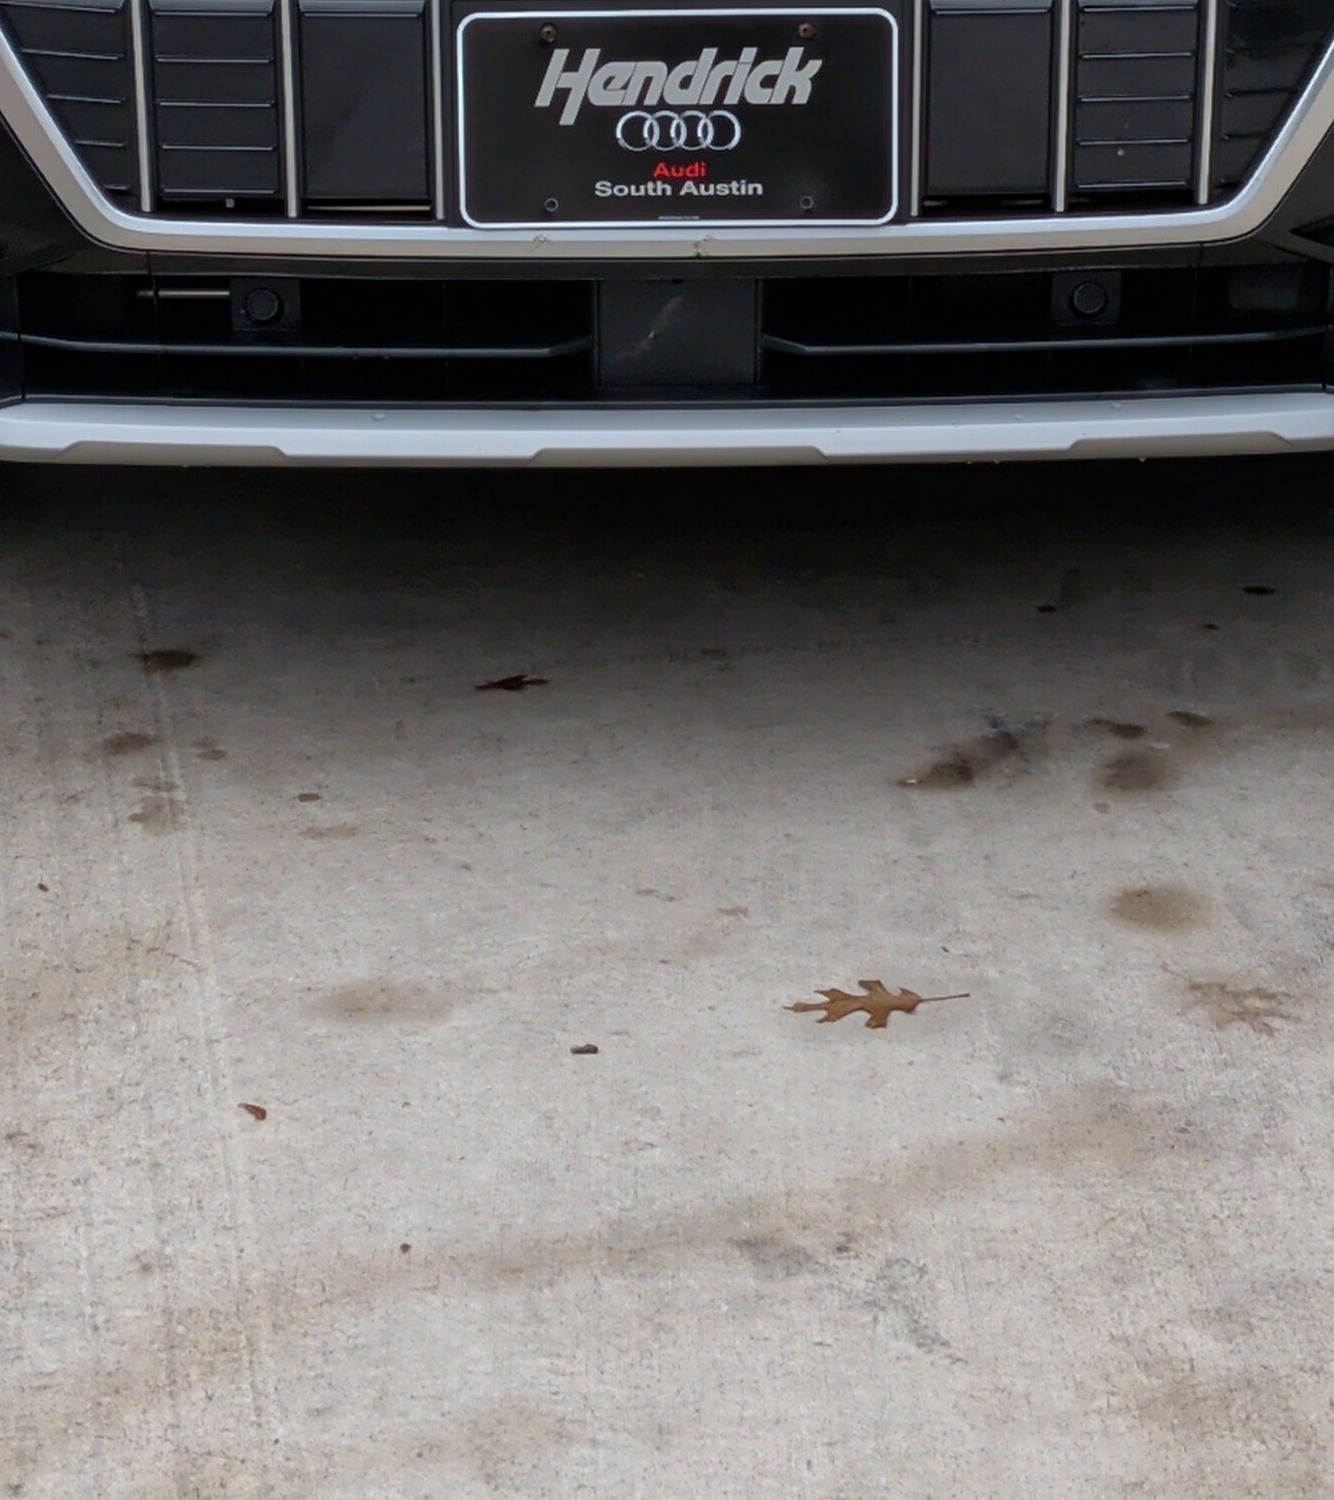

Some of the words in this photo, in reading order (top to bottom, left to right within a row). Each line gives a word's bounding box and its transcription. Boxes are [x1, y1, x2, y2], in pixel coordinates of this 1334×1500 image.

[533, 46, 824, 127] Hendrick
[653, 161, 708, 179] Audi
[594, 180, 673, 198] South
[679, 179, 764, 197] Austin
